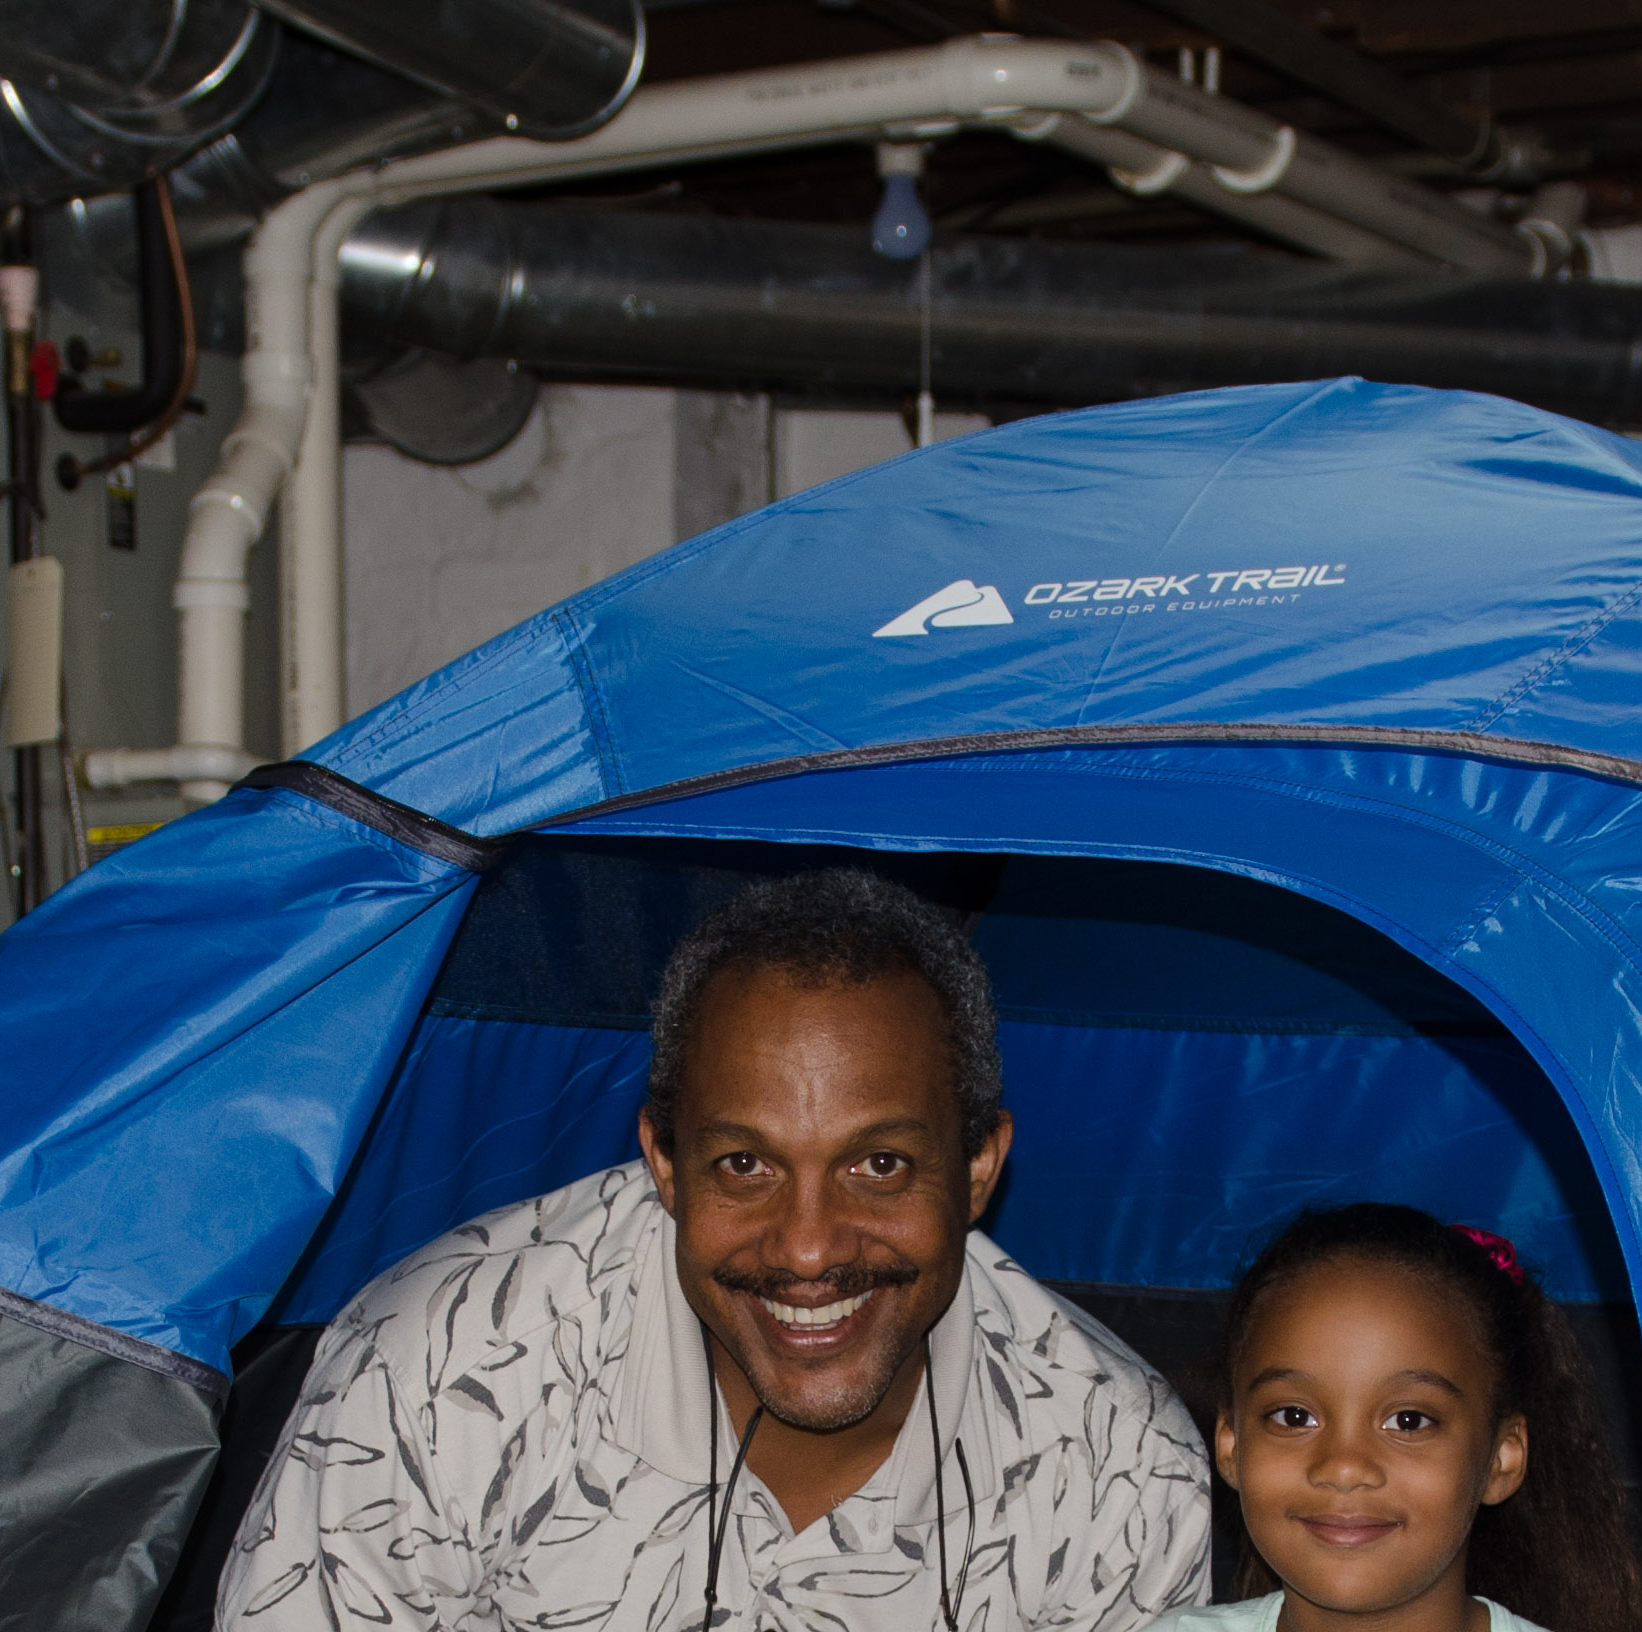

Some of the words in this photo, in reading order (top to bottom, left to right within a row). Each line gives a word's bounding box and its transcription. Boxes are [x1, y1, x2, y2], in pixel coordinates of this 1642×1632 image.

[1024, 573, 1200, 604] OZARK
[1049, 604, 1156, 619] OUTDOOR
[1166, 594, 1301, 612] EQUIPMENT
